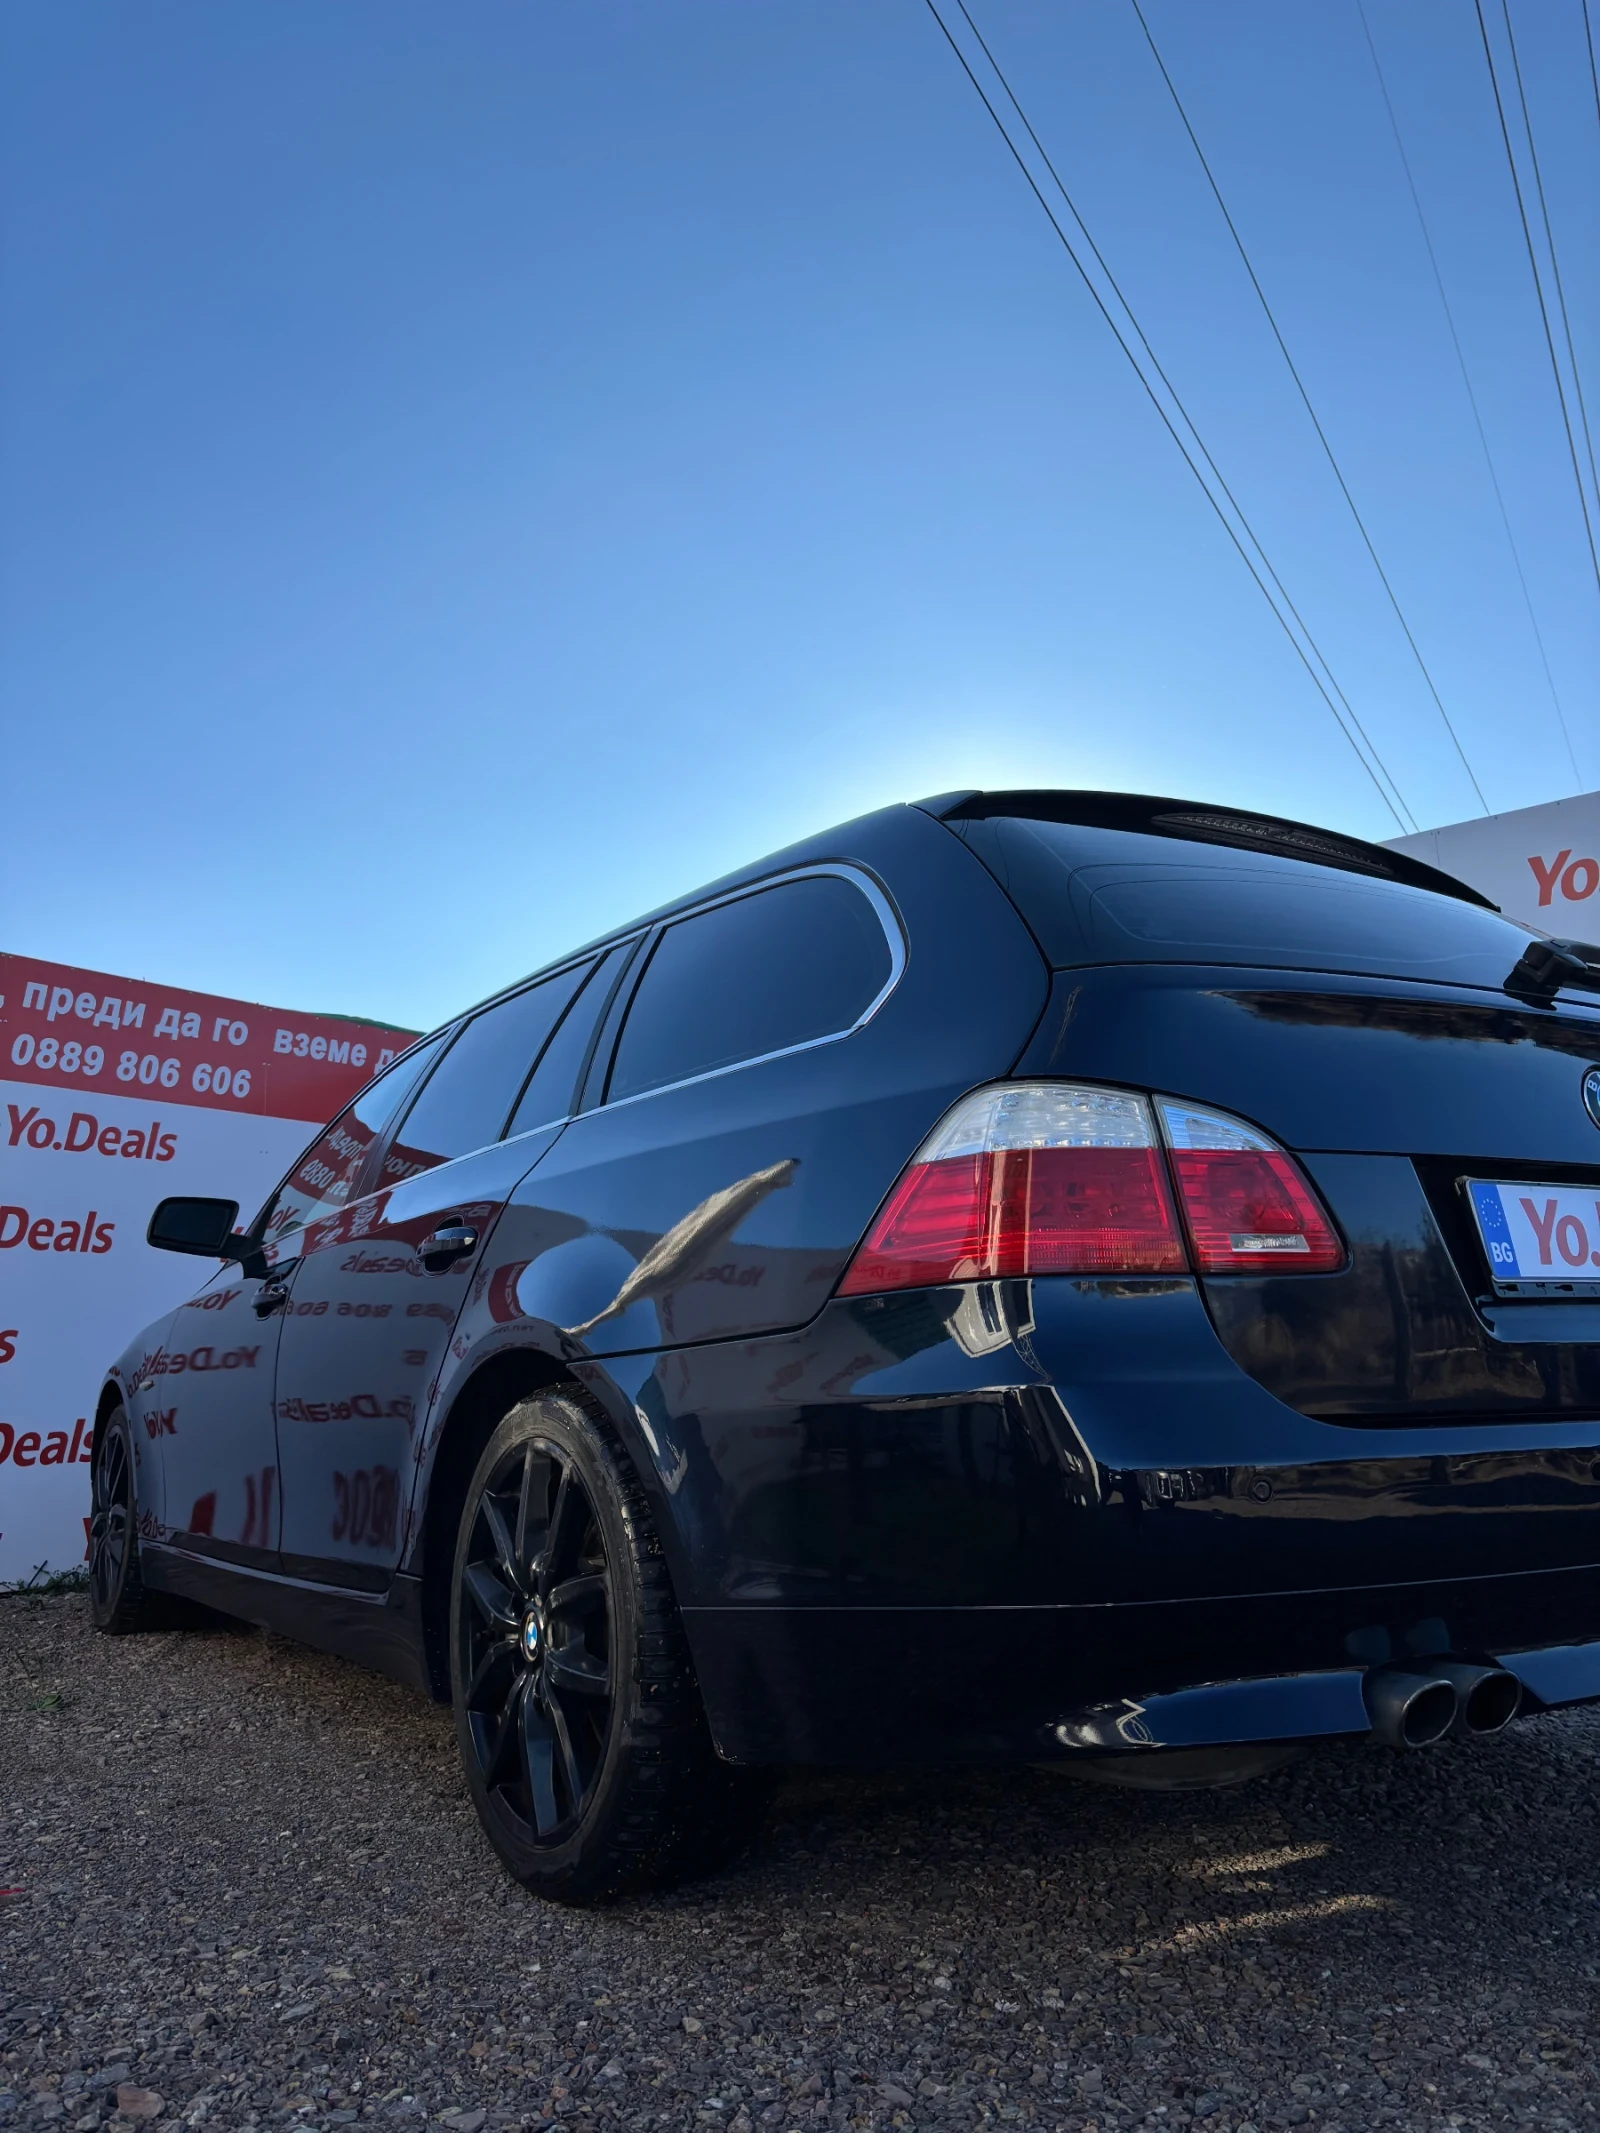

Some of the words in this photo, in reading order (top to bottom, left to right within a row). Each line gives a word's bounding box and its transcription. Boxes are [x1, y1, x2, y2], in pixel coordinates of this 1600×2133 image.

[22, 981, 146, 1030] преди
[154, 1008, 200, 1041] да
[212, 1017, 248, 1046] го
[274, 1028, 366, 1067] вземе
[11, 1033, 104, 1076] 0889
[116, 1051, 181, 1087] 806
[192, 1064, 251, 1098] 606
[7, 1104, 178, 1162] Yo.Deals
[0, 1206, 115, 1254] Deals
[1490, 1242, 1513, 1262] BG
[1519, 1198, 1600, 1267] Yo.
